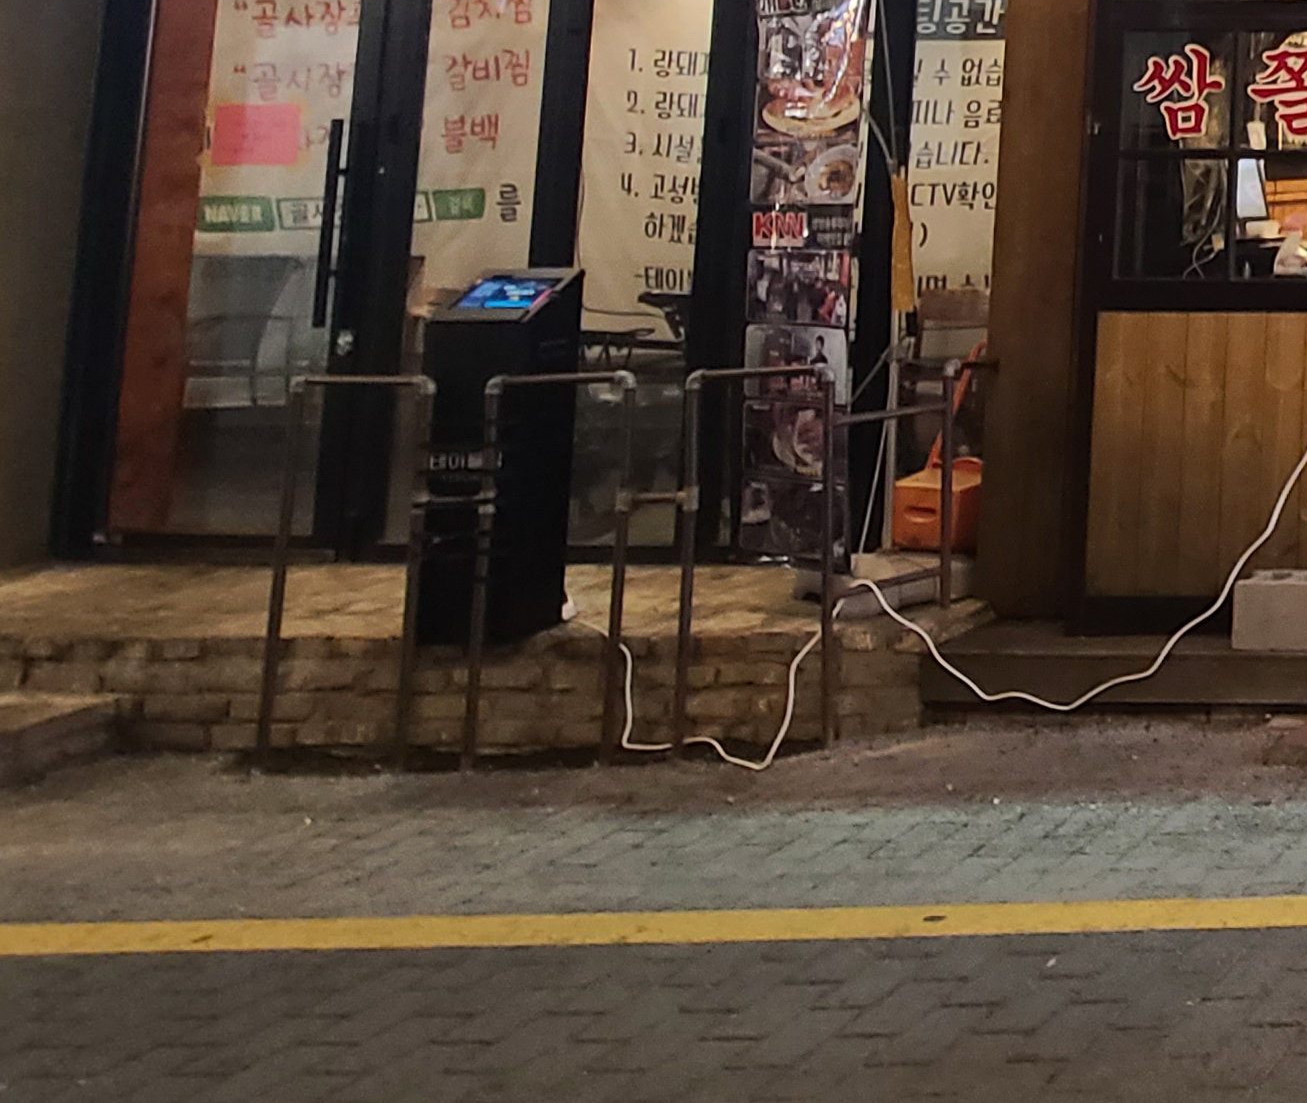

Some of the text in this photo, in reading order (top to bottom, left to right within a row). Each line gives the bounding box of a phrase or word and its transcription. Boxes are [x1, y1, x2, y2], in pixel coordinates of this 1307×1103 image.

[445, 49, 530, 91] 갈비찜
[655, 92, 705, 119] 랑돼
[441, 114, 499, 154] 불백
